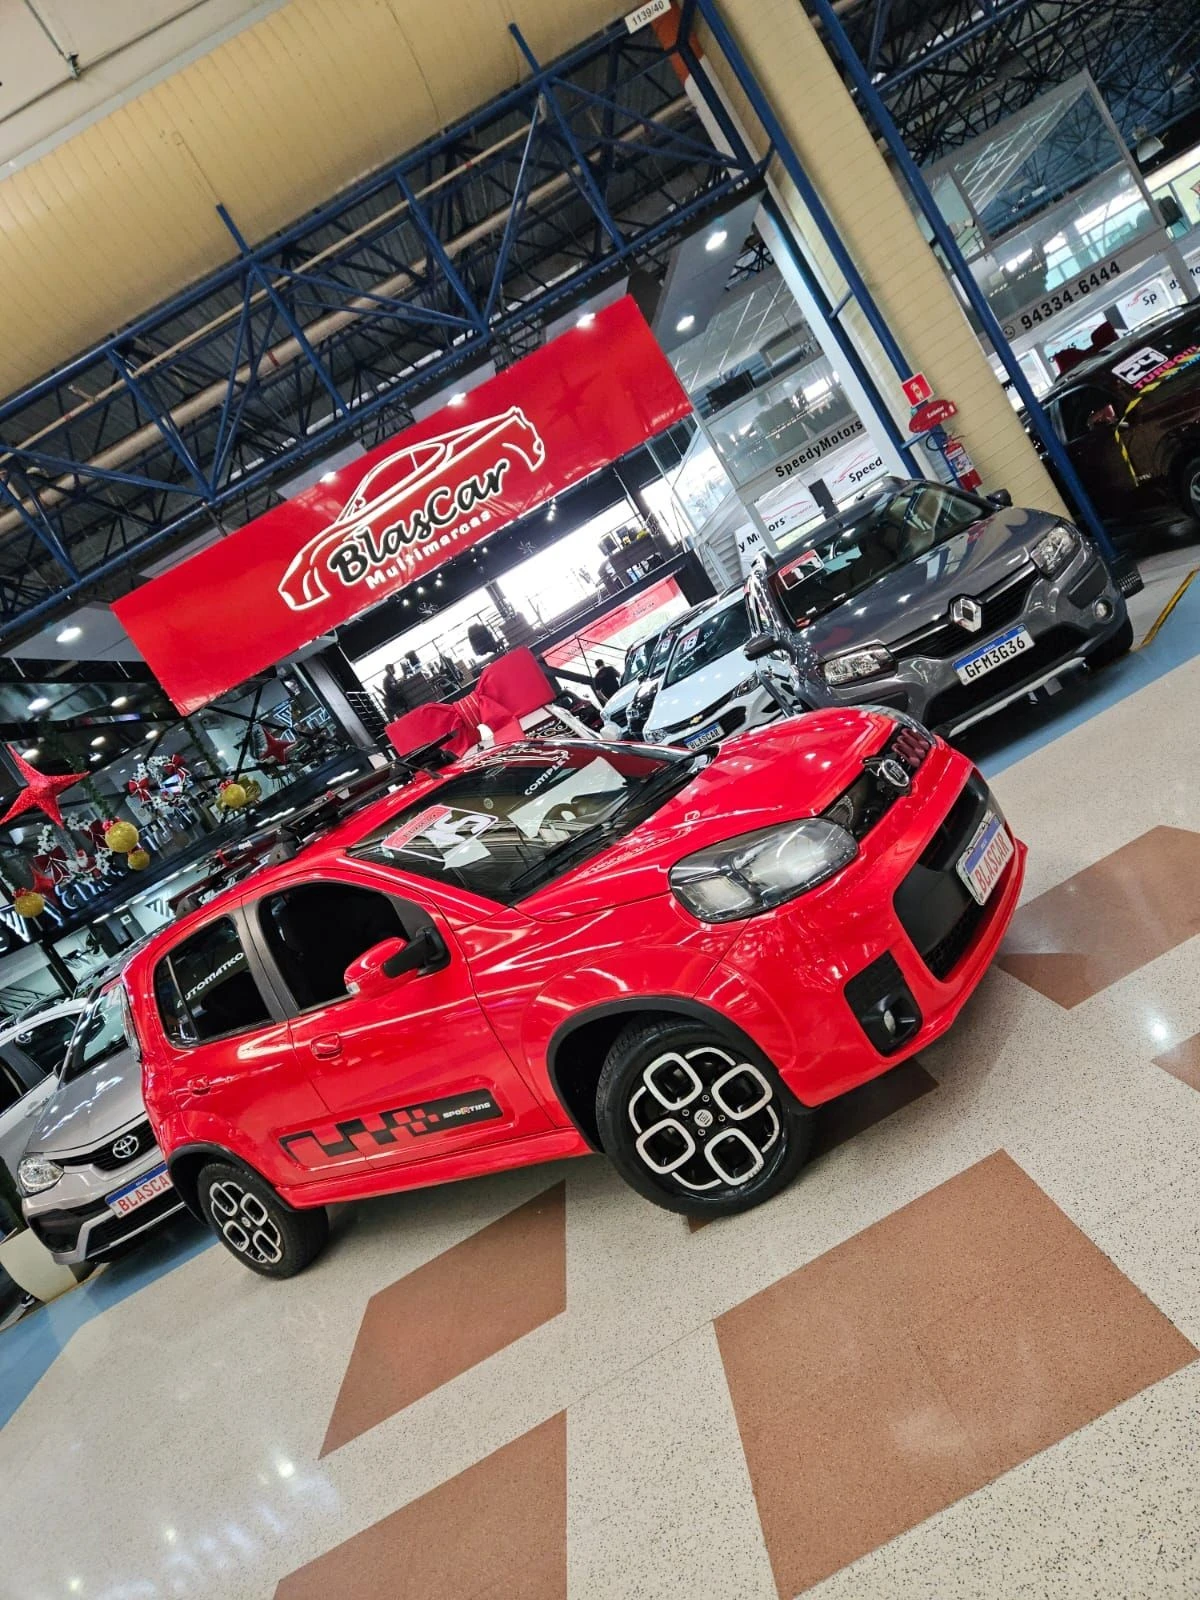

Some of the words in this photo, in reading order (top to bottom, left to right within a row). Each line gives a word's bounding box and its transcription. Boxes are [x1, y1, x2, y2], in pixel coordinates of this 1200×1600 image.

[632, 0, 664, 25] 1139/40
[1021, 261, 1121, 330] 94334-6444
[1124, 351, 1165, 382] 24
[775, 420, 863, 478] SpeedyMotors
[848, 457, 883, 483] Speed
[328, 460, 509, 584] BlasCar
[364, 510, 492, 590] Multimarcas
[964, 636, 1026, 678] GFM3G36
[974, 832, 1010, 894] BLASCAR
